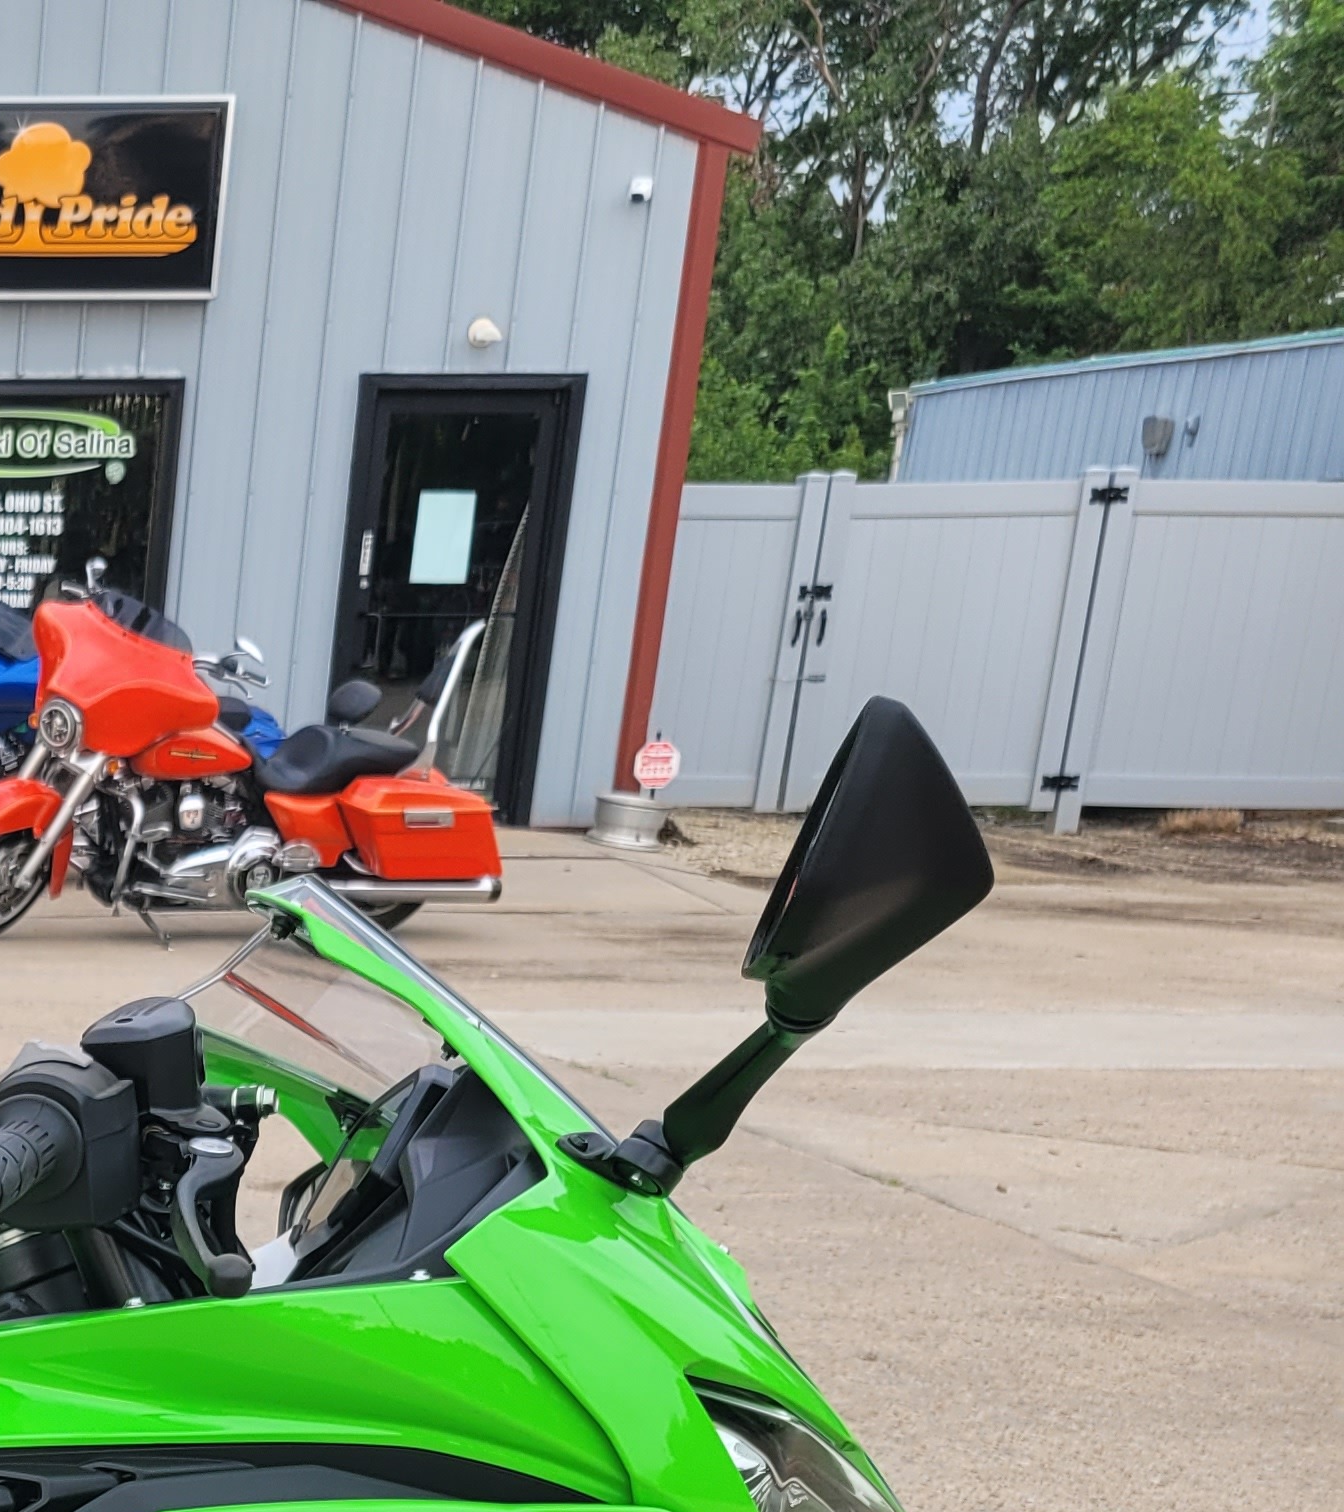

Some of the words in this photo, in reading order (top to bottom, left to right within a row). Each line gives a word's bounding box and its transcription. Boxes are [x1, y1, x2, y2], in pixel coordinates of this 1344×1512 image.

[52, 194, 195, 239] Pride
[17, 430, 49, 458] Of
[55, 430, 136, 458] Salina
[4, 490, 41, 513] OHIO
[15, 555, 57, 574] FRIDAY
